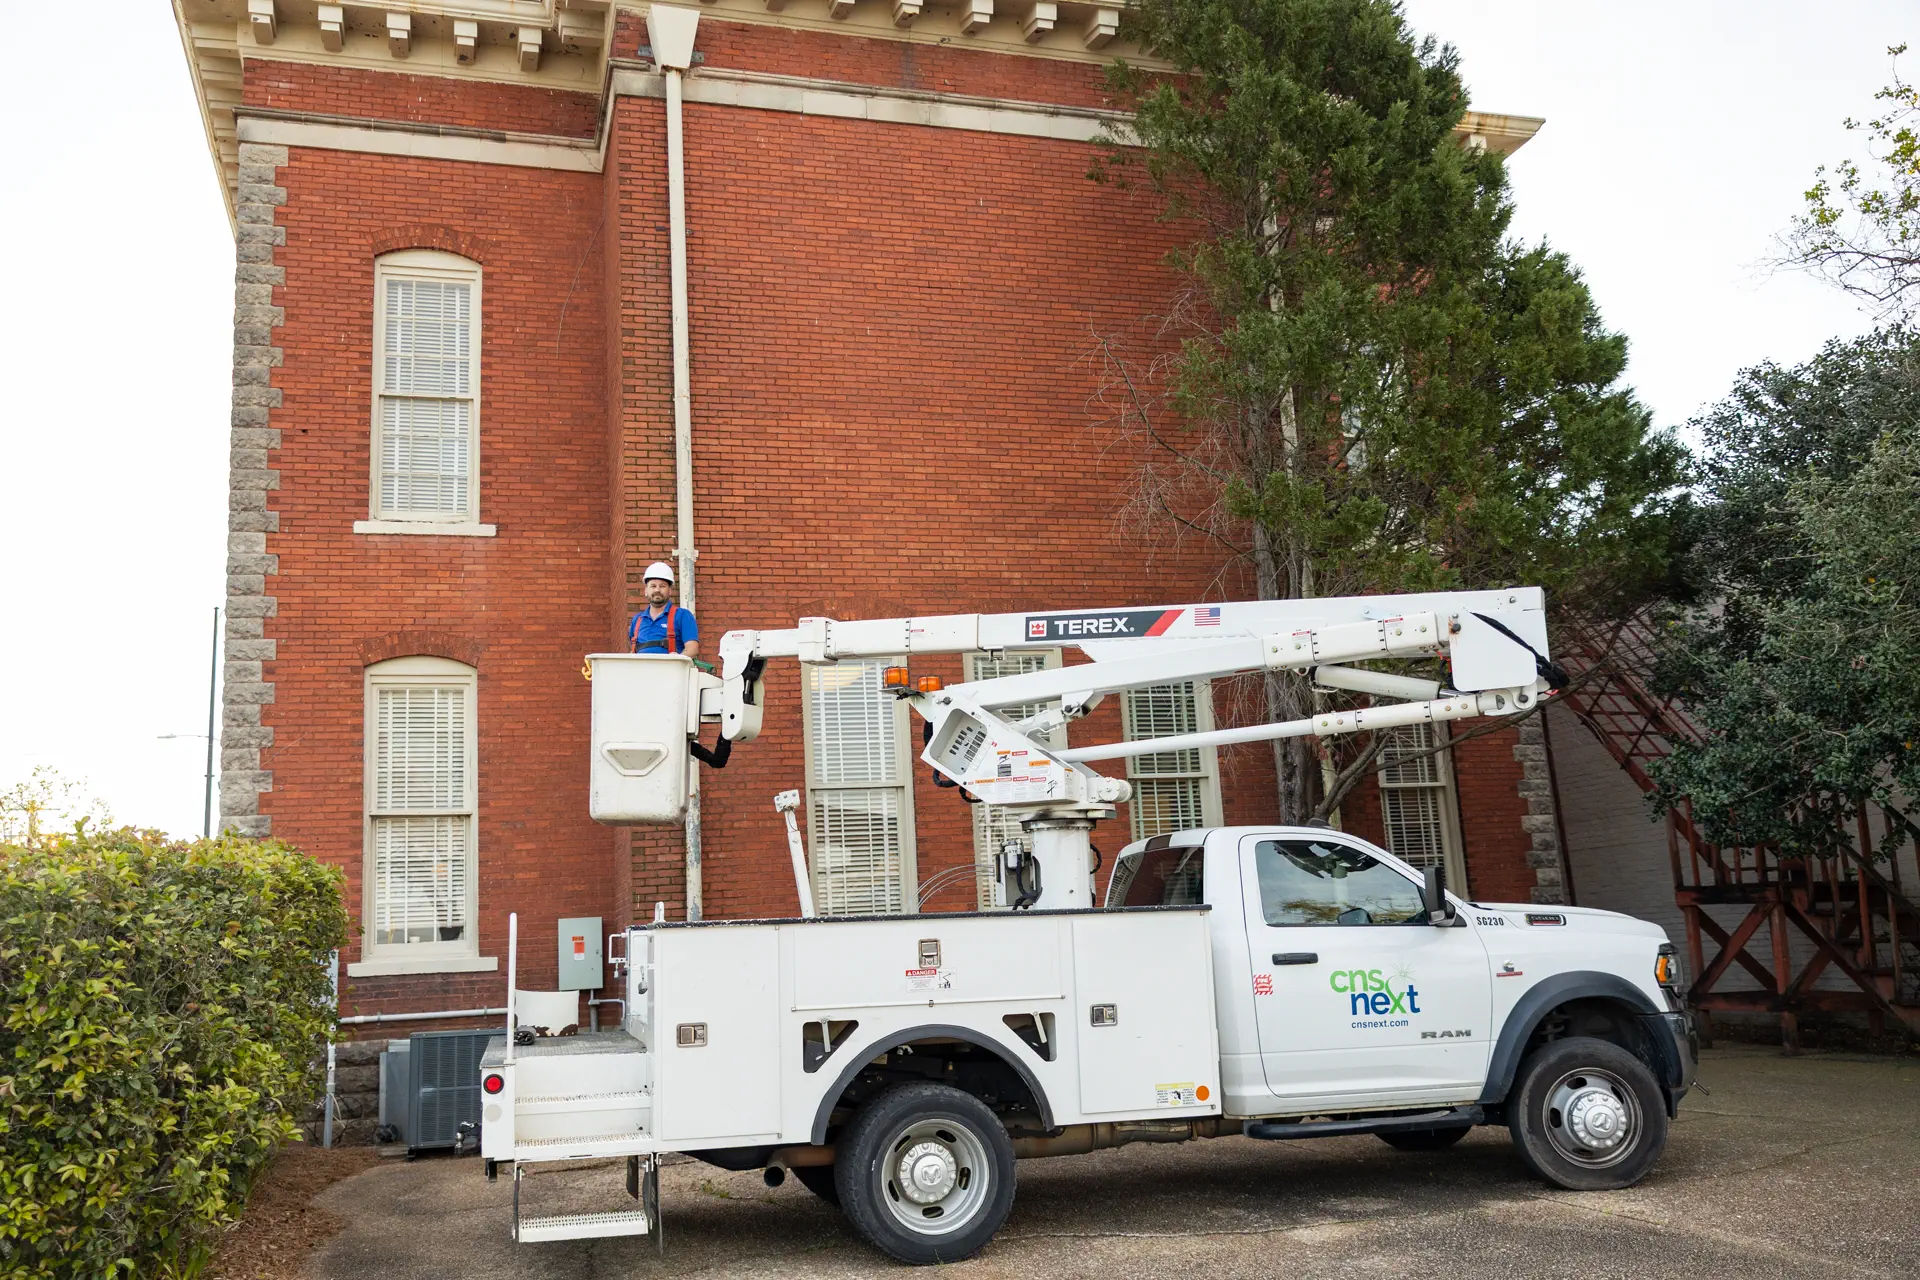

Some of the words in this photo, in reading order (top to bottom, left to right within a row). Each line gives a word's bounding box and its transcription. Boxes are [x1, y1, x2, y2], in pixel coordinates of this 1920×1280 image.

[1054, 617, 1129, 635] TEREX
[1476, 916, 1504, 926] SG230
[1329, 969, 1385, 993] cns
[1350, 984, 1421, 1016] next
[1351, 1019, 1409, 1029] cnsnext.com
[1420, 1029, 1472, 1039] RAM
